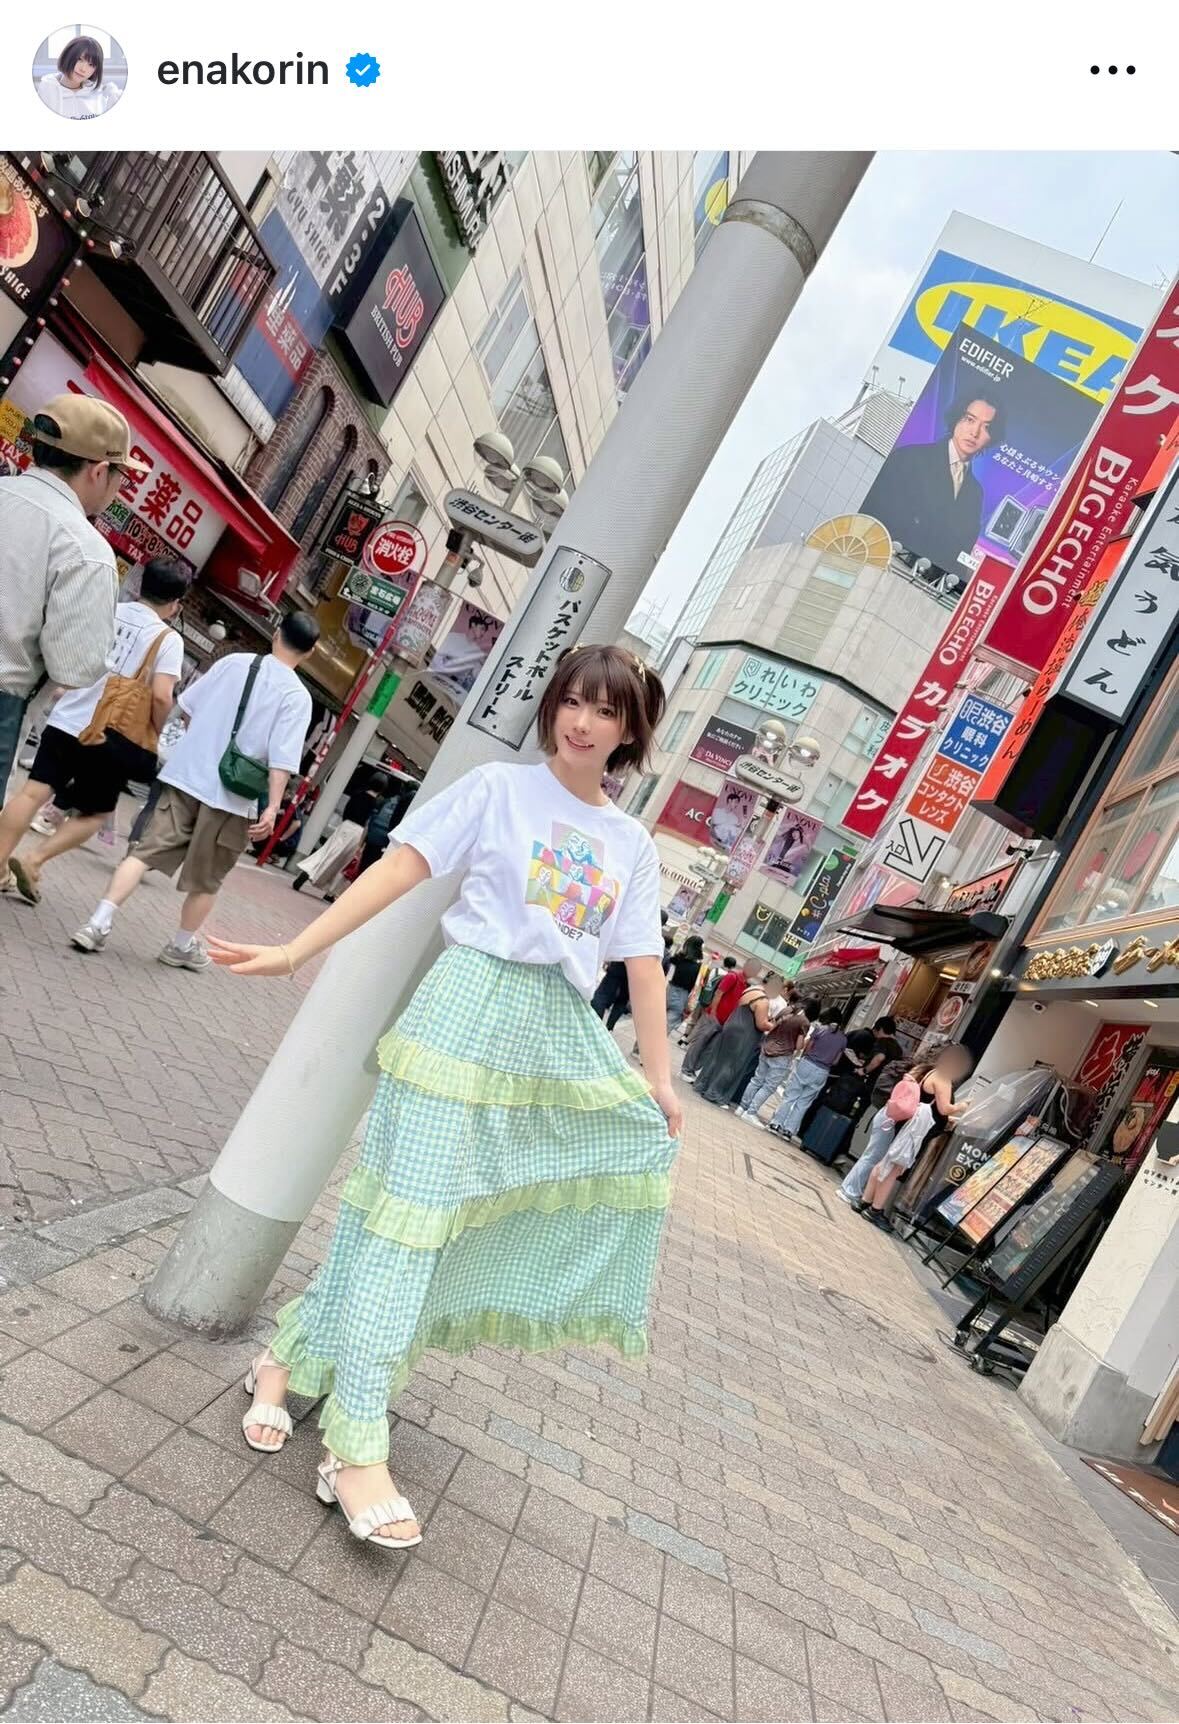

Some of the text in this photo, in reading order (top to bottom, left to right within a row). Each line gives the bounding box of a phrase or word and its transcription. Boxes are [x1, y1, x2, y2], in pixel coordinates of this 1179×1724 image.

[287, 190, 331, 268] GYU SHIGE
[382, 264, 424, 348] HUB
[371, 304, 403, 368] BRITISH PUB
[933, 290, 1128, 391] IKEA
[959, 338, 1014, 378] EDIFIER
[961, 356, 1001, 383] www.edifier.jp
[1, 441, 22, 463] TAX
[1078, 446, 1132, 519] BIG
[1108, 477, 1139, 523] Karaoke
[449, 497, 538, 544] 渋谷センター街
[127, 544, 143, 561] TAX
[334, 533, 358, 554] HUB
[375, 539, 413, 566] 消火栓
[1022, 519, 1093, 615] ECHO
[1062, 526, 1113, 610] Entertainment
[965, 579, 995, 620] BIG
[512, 600, 582, 702] バスケットボール
[939, 617, 975, 665] ECHO
[481, 656, 525, 719] ストリート
[732, 681, 808, 717] クリニック
[760, 667, 817, 698] れいわ
[960, 727, 988, 748] 眼科
[977, 709, 1010, 735] 渋谷
[717, 753, 733, 767] VINCI
[857, 681, 949, 811] カラオケ
[942, 738, 989, 769] クリニック
[739, 760, 801, 793] 渋谷センター街
[946, 768, 977, 796] 渋谷
[917, 782, 965, 812] コンタクト
[919, 801, 950, 823] レンズ
[885, 840, 905, 856] 入口
[555, 919, 584, 941] NDE?
